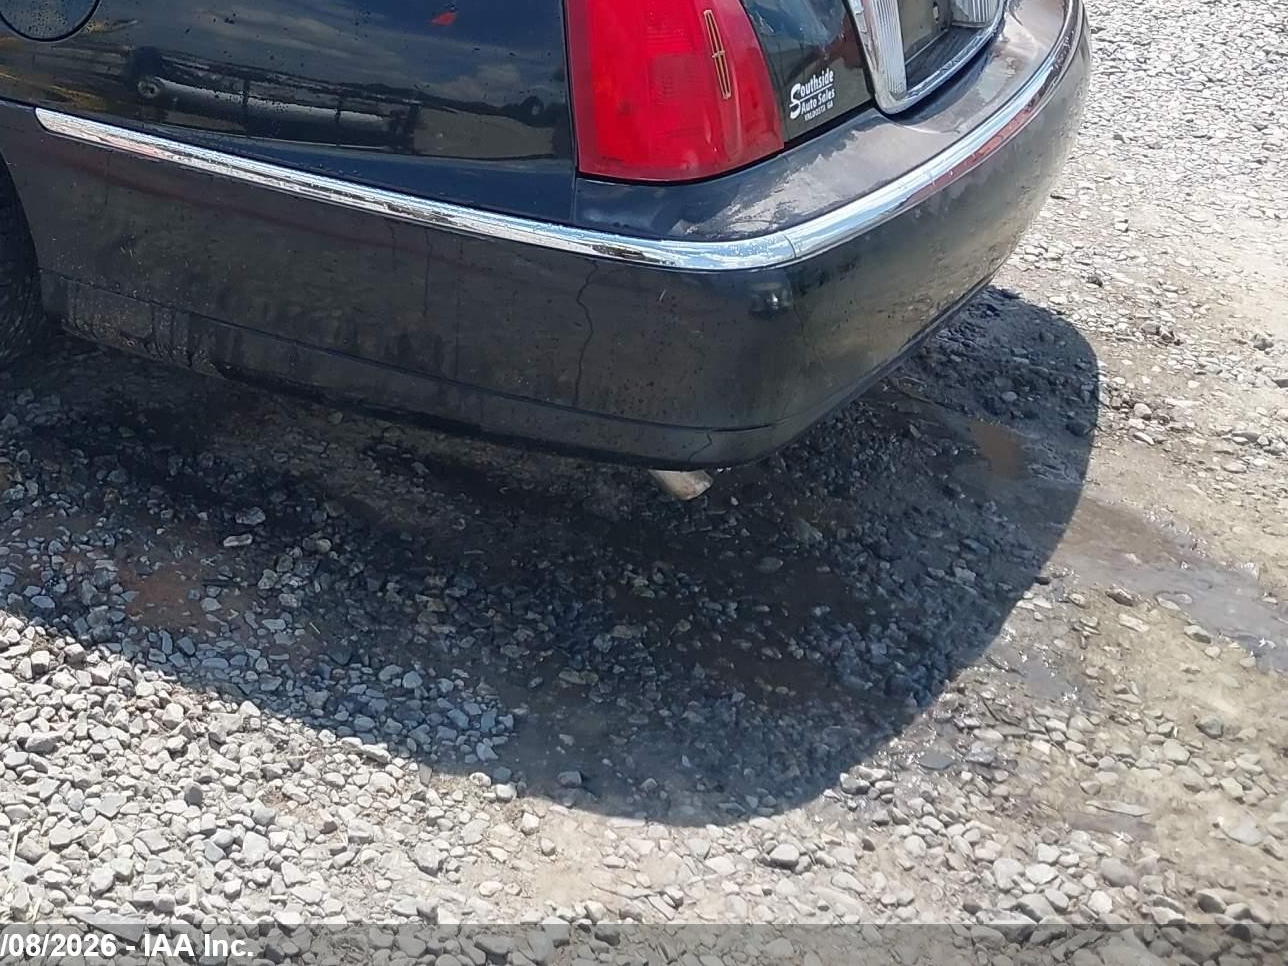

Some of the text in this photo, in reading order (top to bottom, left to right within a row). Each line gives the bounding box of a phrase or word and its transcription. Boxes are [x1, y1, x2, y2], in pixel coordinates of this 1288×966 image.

[789, 67, 834, 119] Southside
[801, 88, 835, 114] Auto Sales
